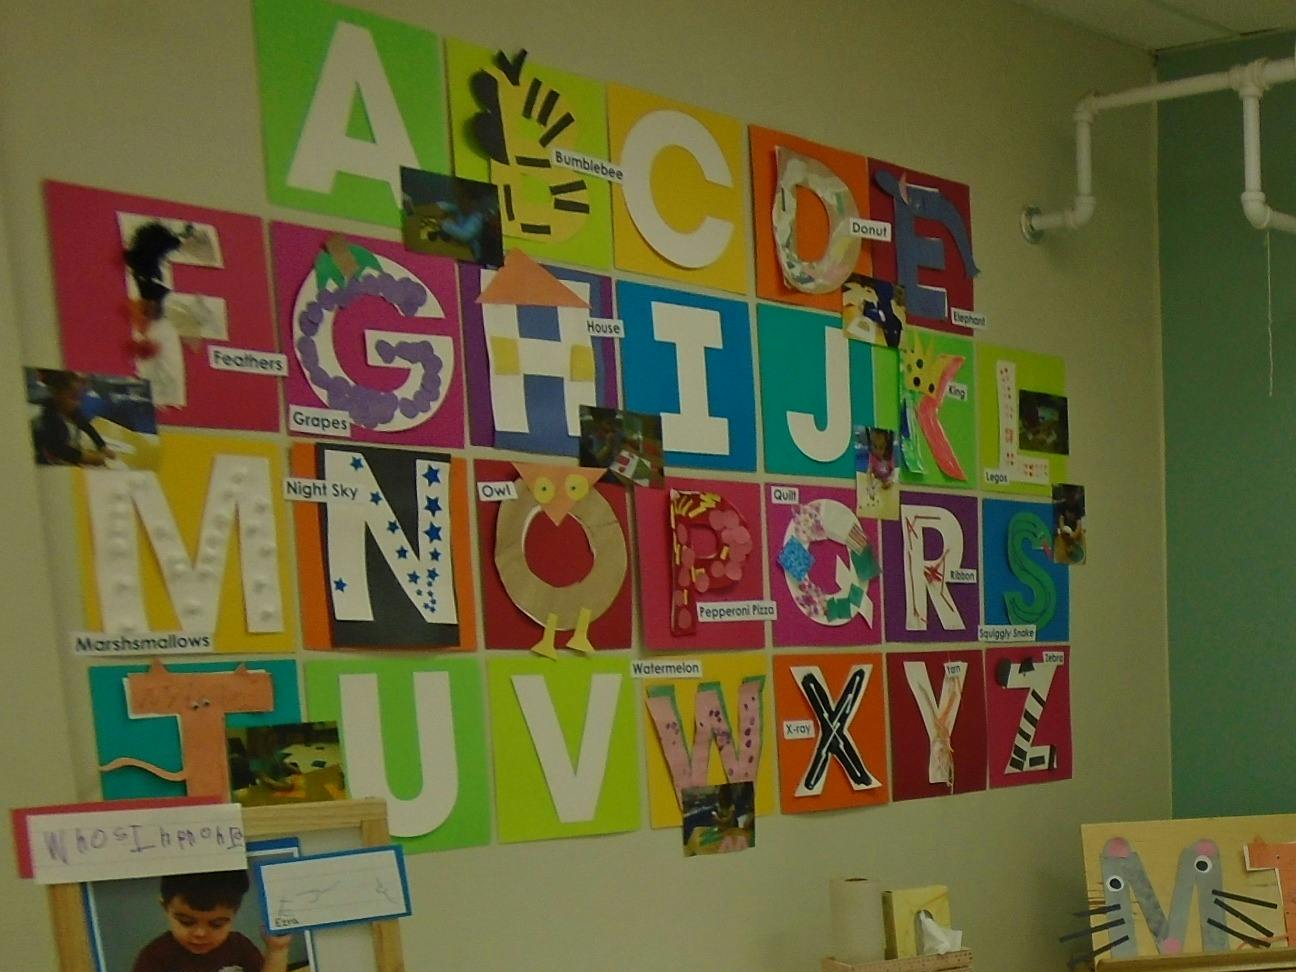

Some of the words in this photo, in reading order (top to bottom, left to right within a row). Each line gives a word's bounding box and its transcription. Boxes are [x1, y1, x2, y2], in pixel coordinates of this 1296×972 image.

[285, 20, 424, 209] A
[555, 151, 624, 181] Bumblebee
[622, 110, 735, 269] C
[771, 145, 863, 294] D
[852, 222, 888, 238] Donut
[292, 244, 455, 432] G
[587, 320, 620, 335] House
[953, 311, 986, 327] Elephant
[213, 351, 283, 371] Feathers
[651, 301, 730, 455] I
[786, 326, 851, 463] J
[948, 384, 966, 400] King
[293, 410, 348, 432] Grapes
[287, 481, 327, 500] Night
[331, 483, 359, 502] Sky
[482, 483, 511, 498] Owl
[774, 488, 798, 501] Quilt
[985, 471, 1008, 484] Legos
[85, 454, 284, 636] M
[323, 449, 459, 625] N
[669, 487, 752, 637] P
[779, 499, 881, 630] Q
[901, 504, 966, 631] R
[1004, 511, 1057, 632] S
[699, 605, 750, 618] Pepperoni
[752, 604, 775, 616] Pizza
[950, 570, 975, 582] Ribbon
[632, 662, 699, 676] Watermelon
[979, 628, 1011, 640] Squiggly
[1013, 628, 1034, 638] Snake
[1045, 653, 1064, 663] Zebra
[339, 671, 459, 838] U
[511, 673, 623, 823] V
[644, 675, 766, 812] W
[785, 723, 811, 736] X-ray
[790, 664, 882, 797] X
[903, 661, 968, 786] Y
